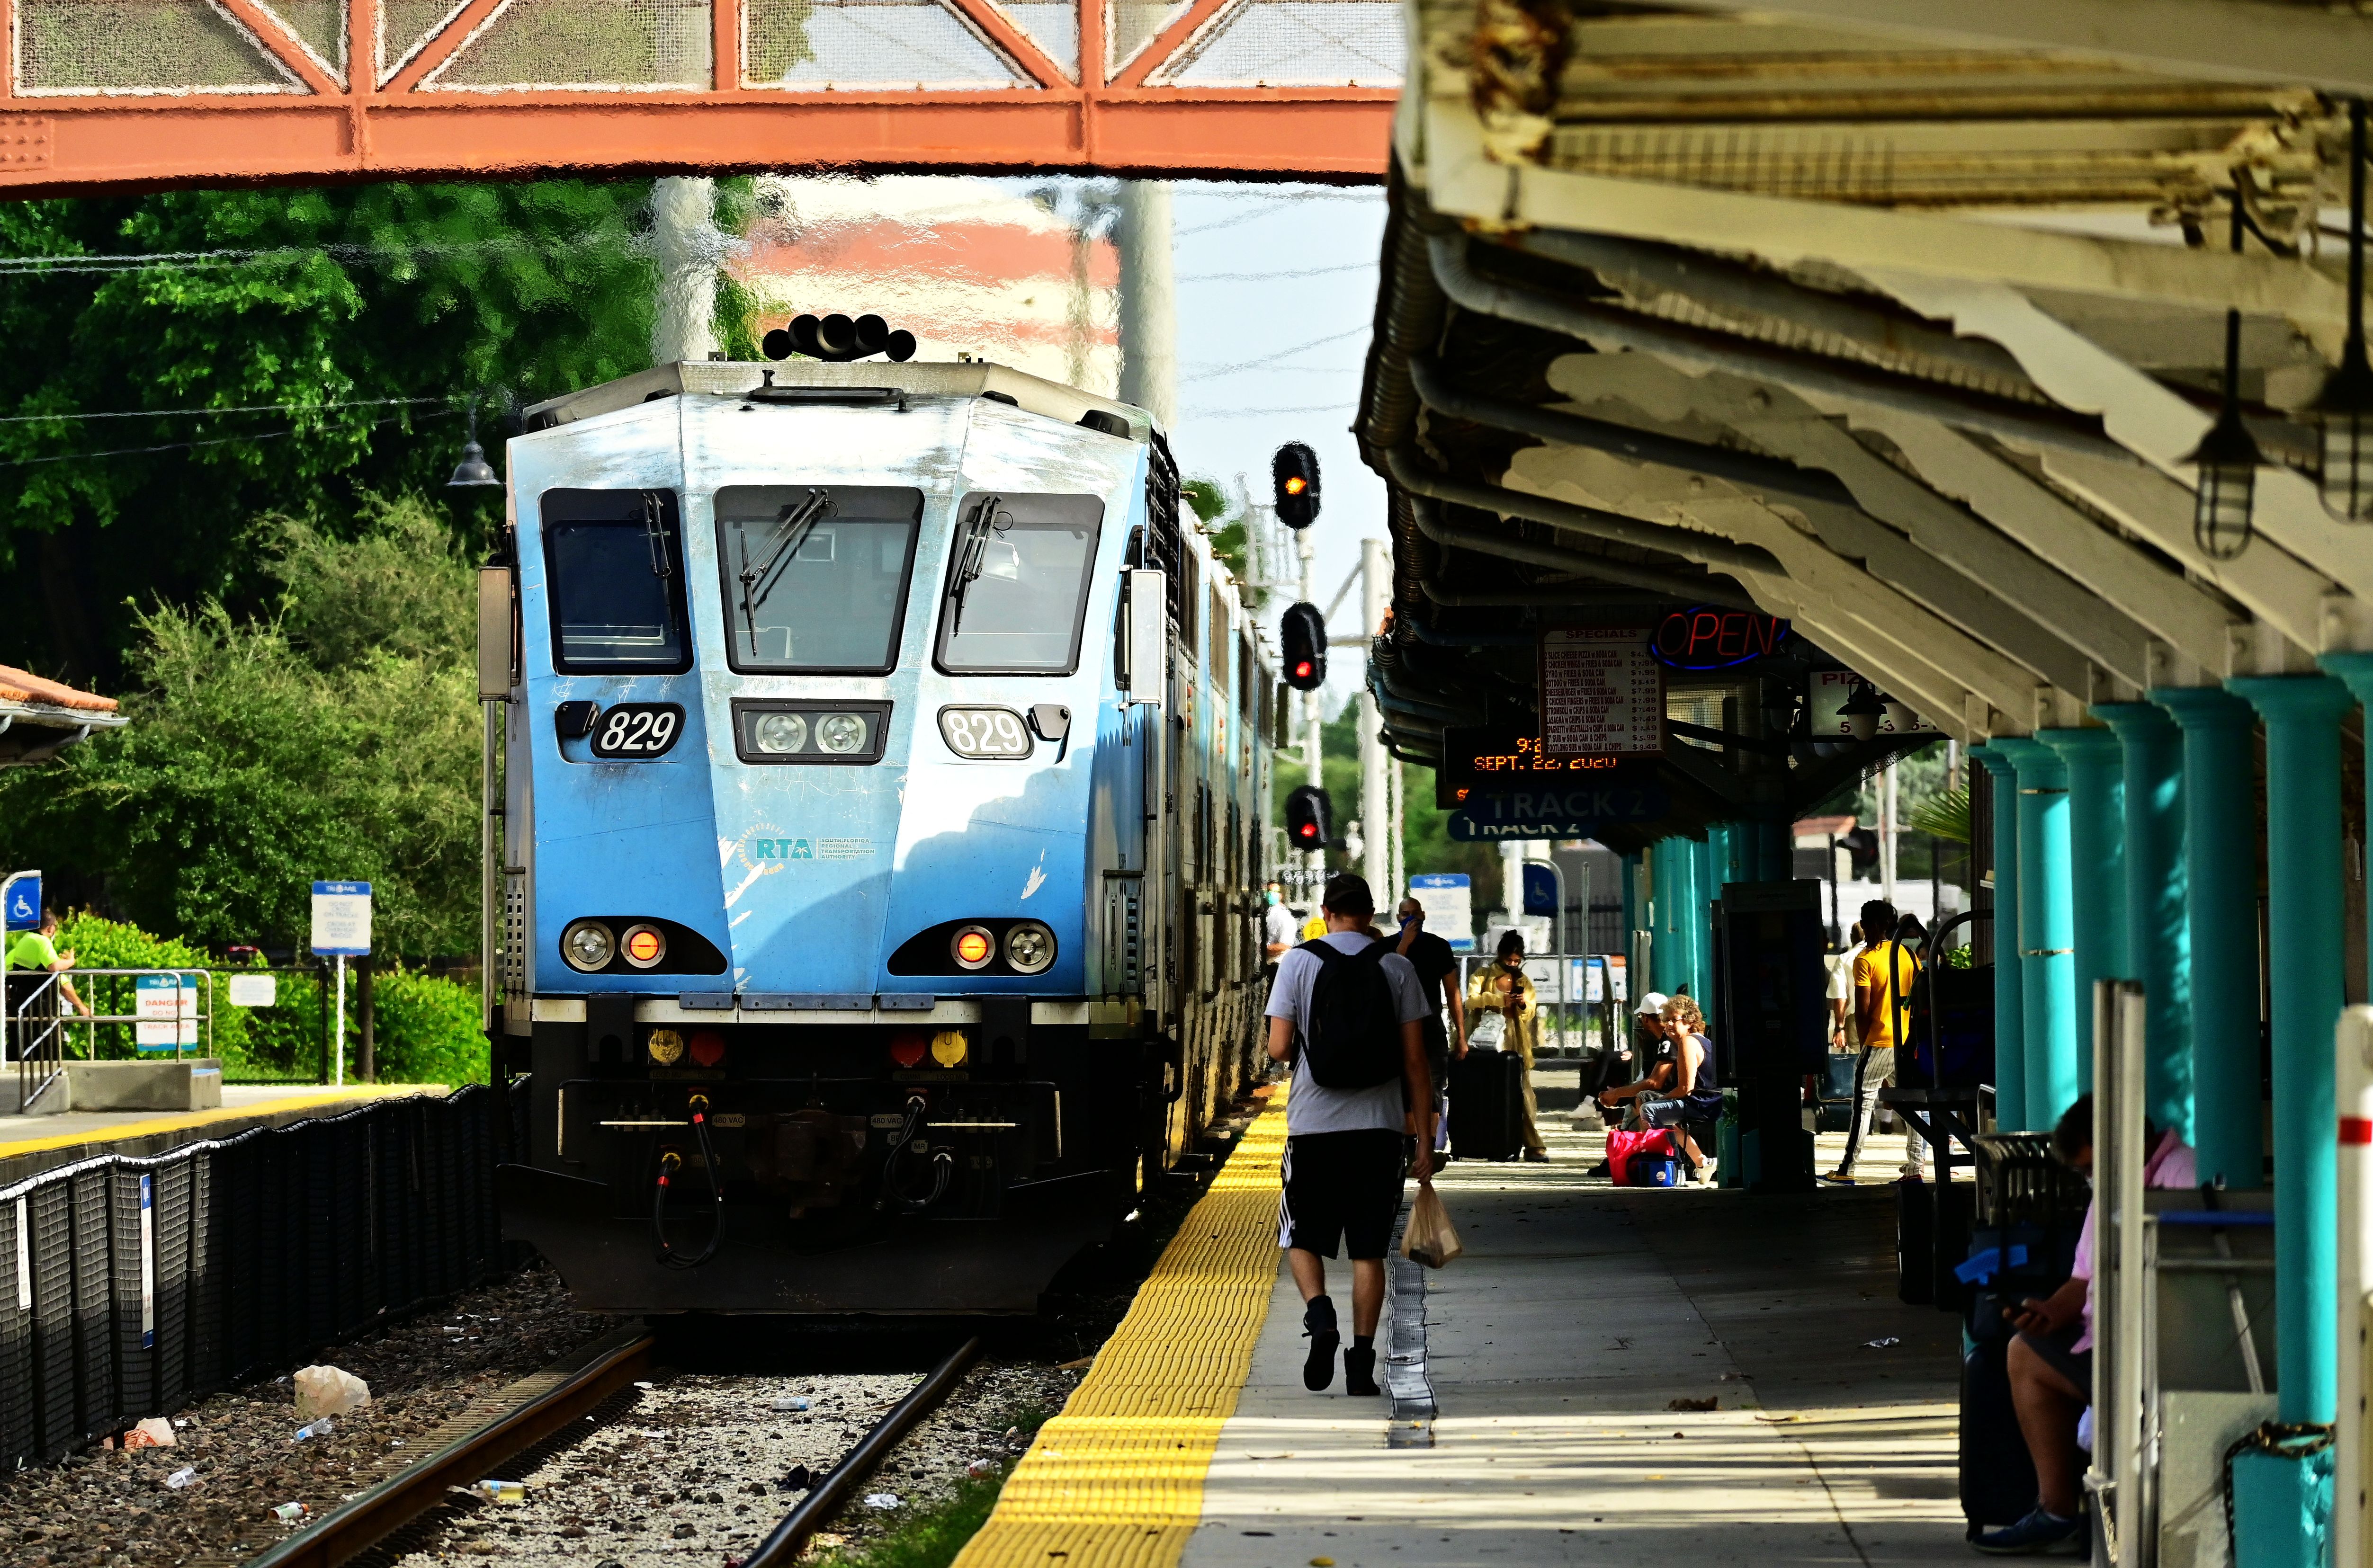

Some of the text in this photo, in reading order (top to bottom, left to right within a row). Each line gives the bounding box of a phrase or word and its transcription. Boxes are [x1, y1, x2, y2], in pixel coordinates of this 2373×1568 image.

[1566, 630, 1637, 639] SPECIALS
[1657, 613, 1776, 656] OPEN
[1546, 669, 1557, 677] GYRO
[1546, 688, 1576, 696] CHEESEBURGER
[600, 709, 676, 751] 829
[947, 709, 1024, 755] 829
[1474, 756, 1616, 770] SEPT. 22, 2020
[1486, 791, 1617, 818] TRACK
[1629, 789, 1646, 816] 2
[756, 838, 814, 859] RTA
